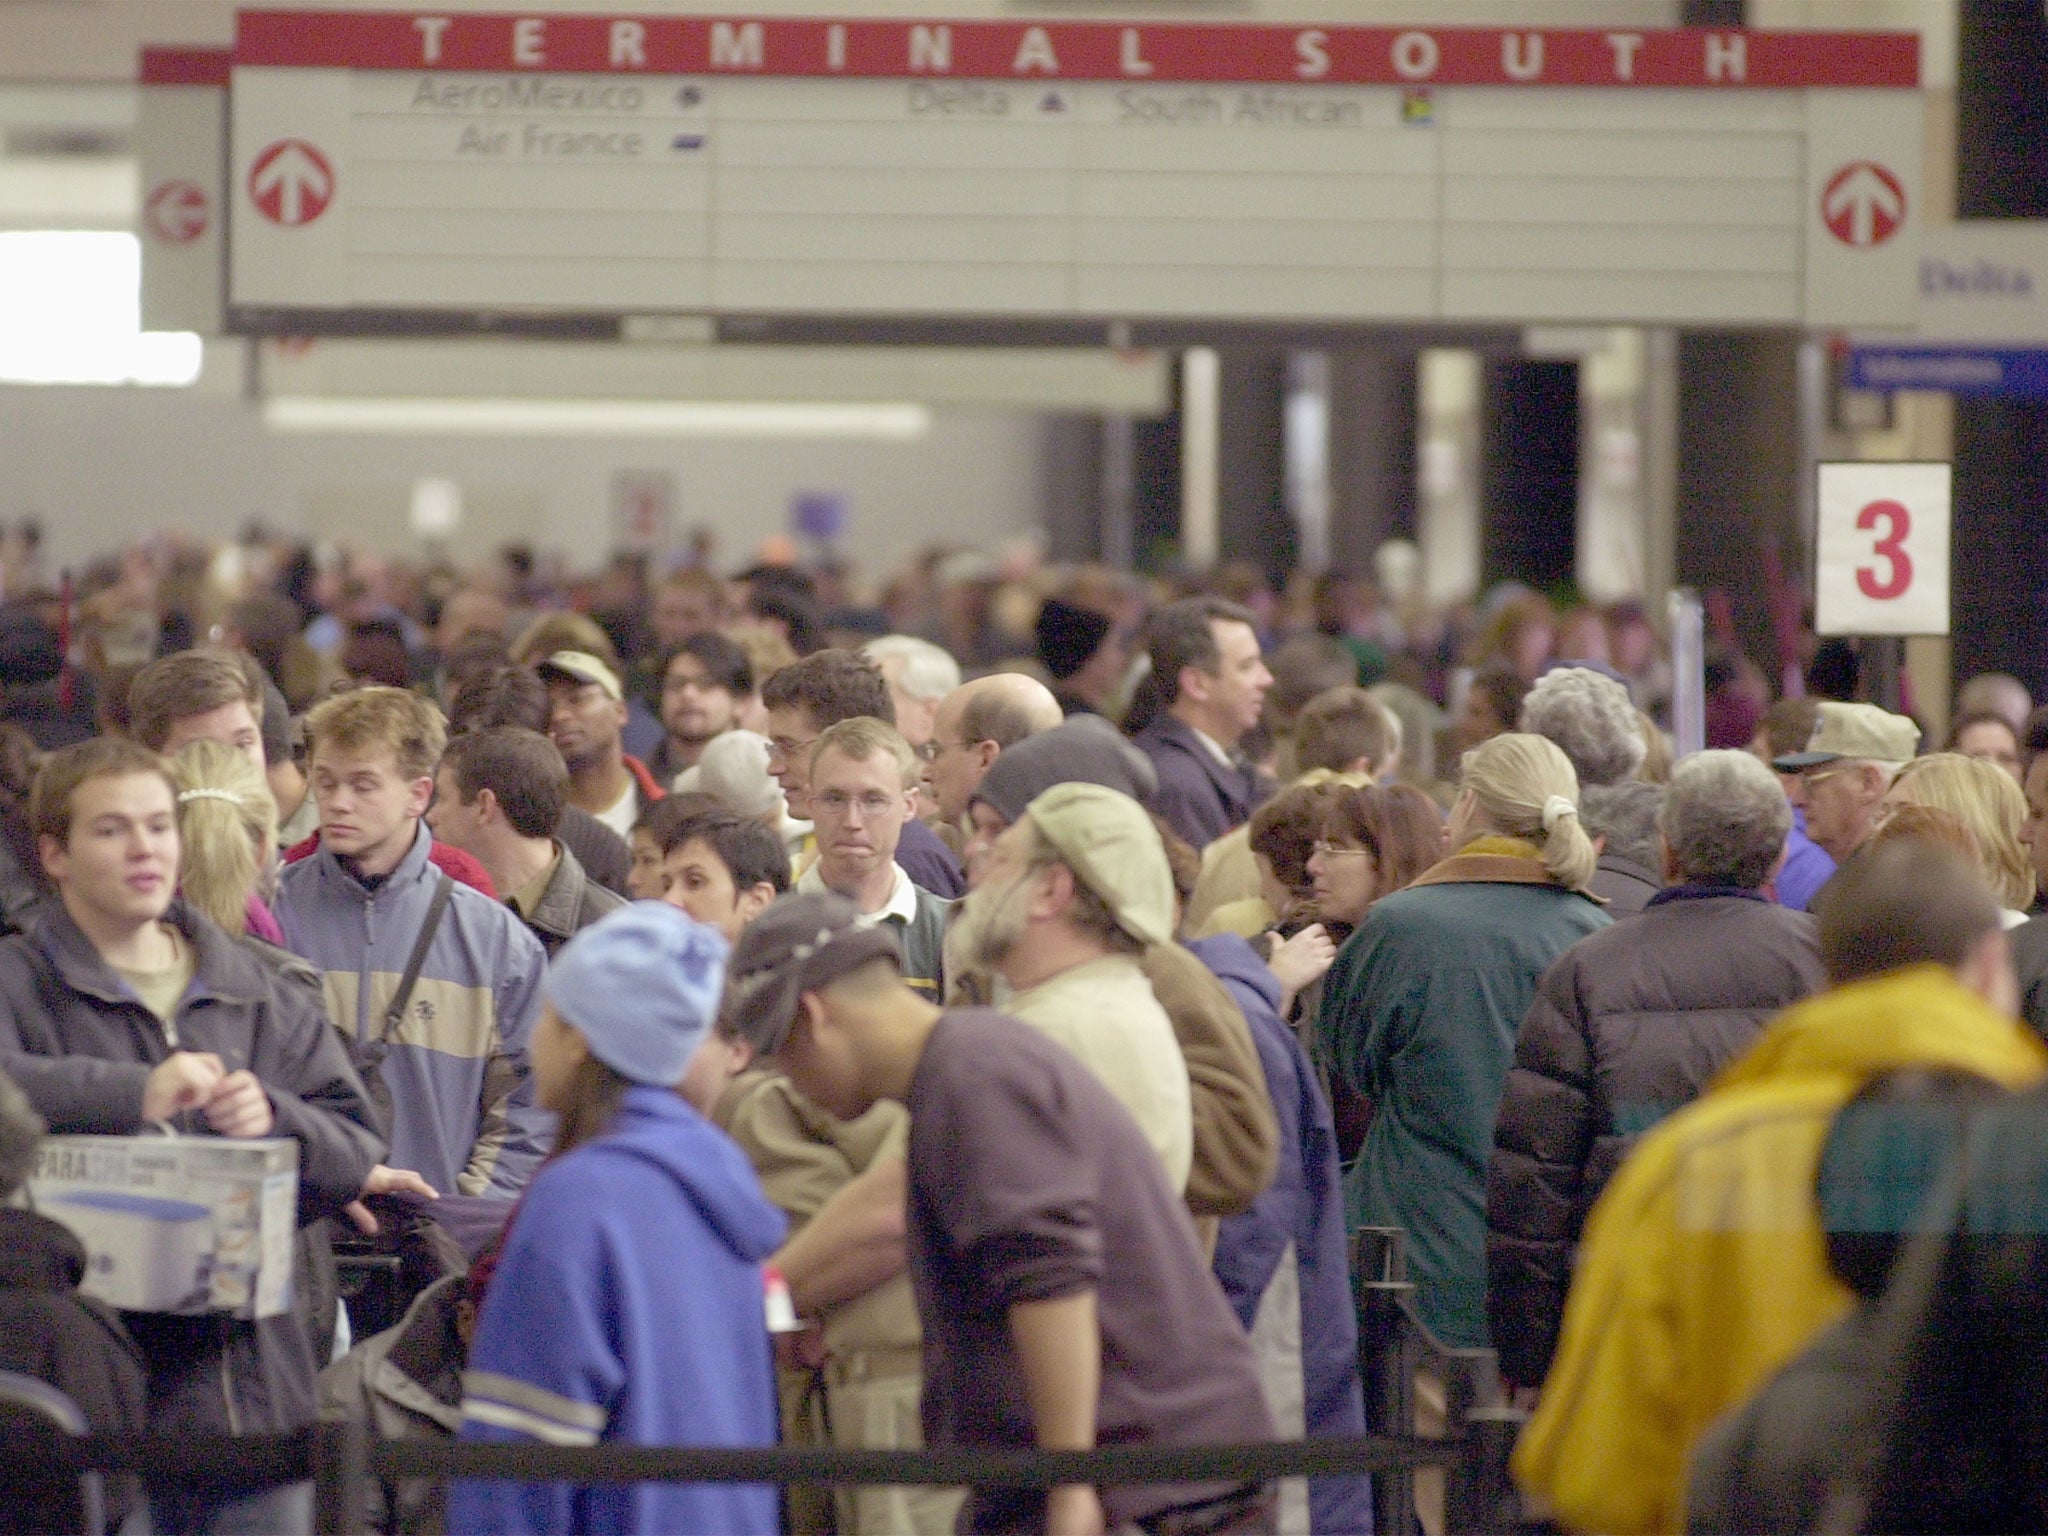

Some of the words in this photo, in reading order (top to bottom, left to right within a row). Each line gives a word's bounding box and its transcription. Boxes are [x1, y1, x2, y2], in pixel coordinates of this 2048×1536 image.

[412, 17, 1153, 74] TERMINAL
[1295, 29, 1748, 82] SOUTH
[411, 74, 644, 110] AeroMexico
[907, 81, 1012, 115] Delta
[1116, 87, 1221, 123] South
[1234, 89, 1362, 125] African
[456, 122, 510, 154] Air
[522, 123, 643, 155] France
[1856, 499, 1913, 600] 3
